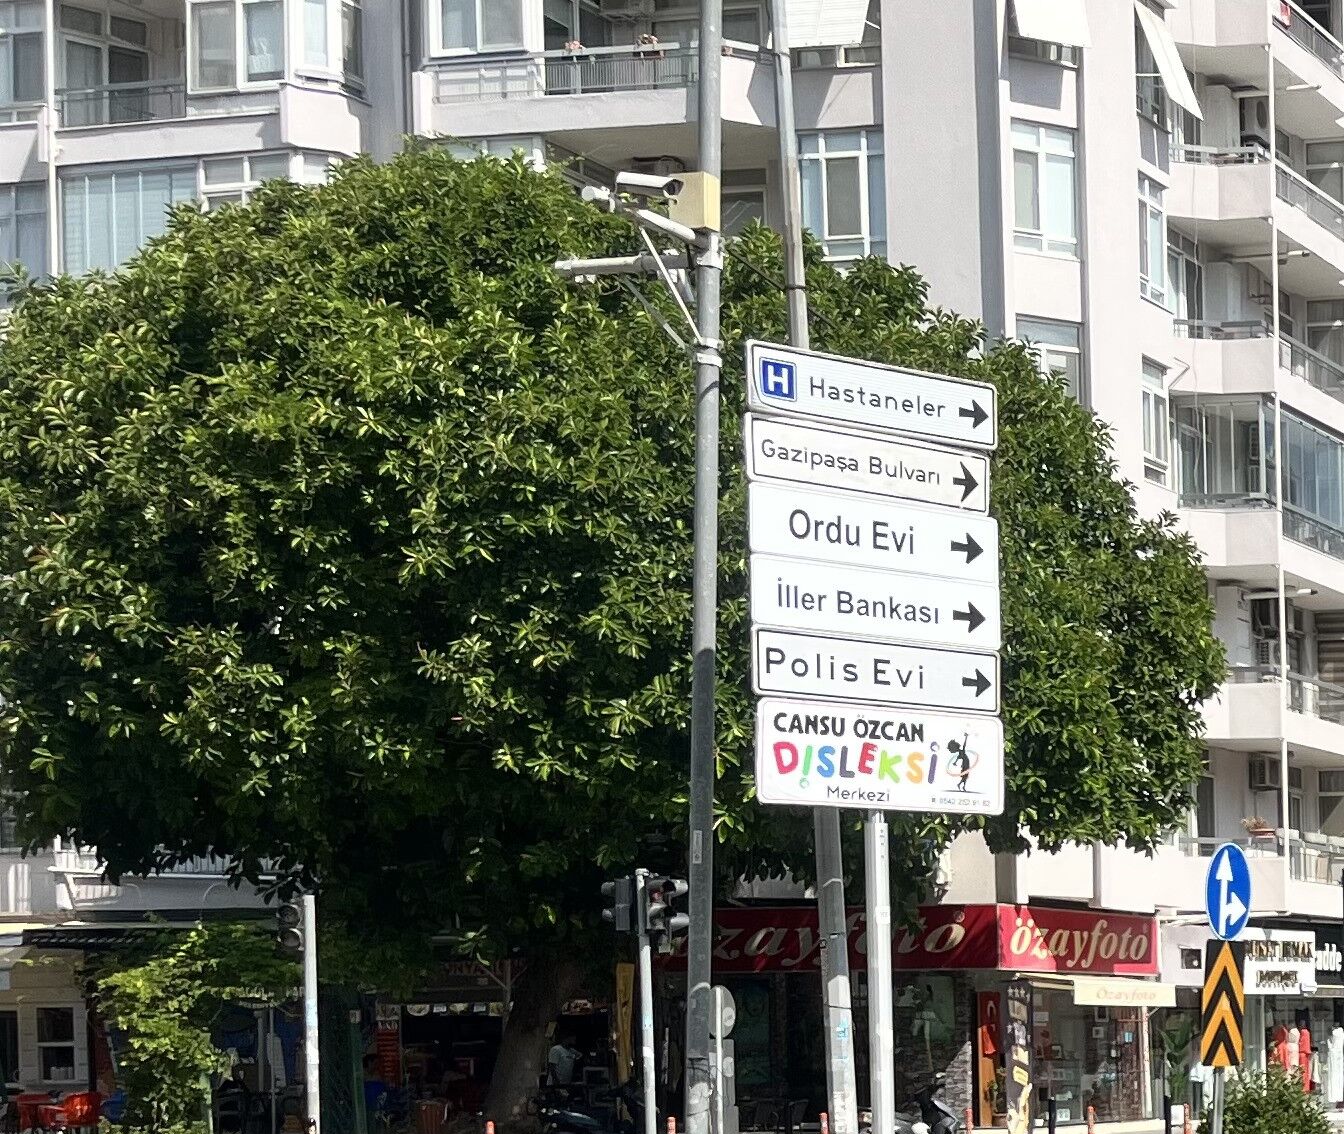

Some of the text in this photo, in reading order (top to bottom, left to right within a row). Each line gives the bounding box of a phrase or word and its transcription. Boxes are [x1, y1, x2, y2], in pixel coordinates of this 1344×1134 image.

[809, 376, 946, 418] Hastaneler
[760, 438, 941, 486] Gazipaşa Bulvarı
[789, 509, 915, 555] Ordu Evi
[777, 576, 940, 625] İller Bankası
[765, 647, 925, 690] Polis Evi
[773, 712, 925, 743] CANSU ÖZCAN
[827, 785, 891, 802] Merkezi
